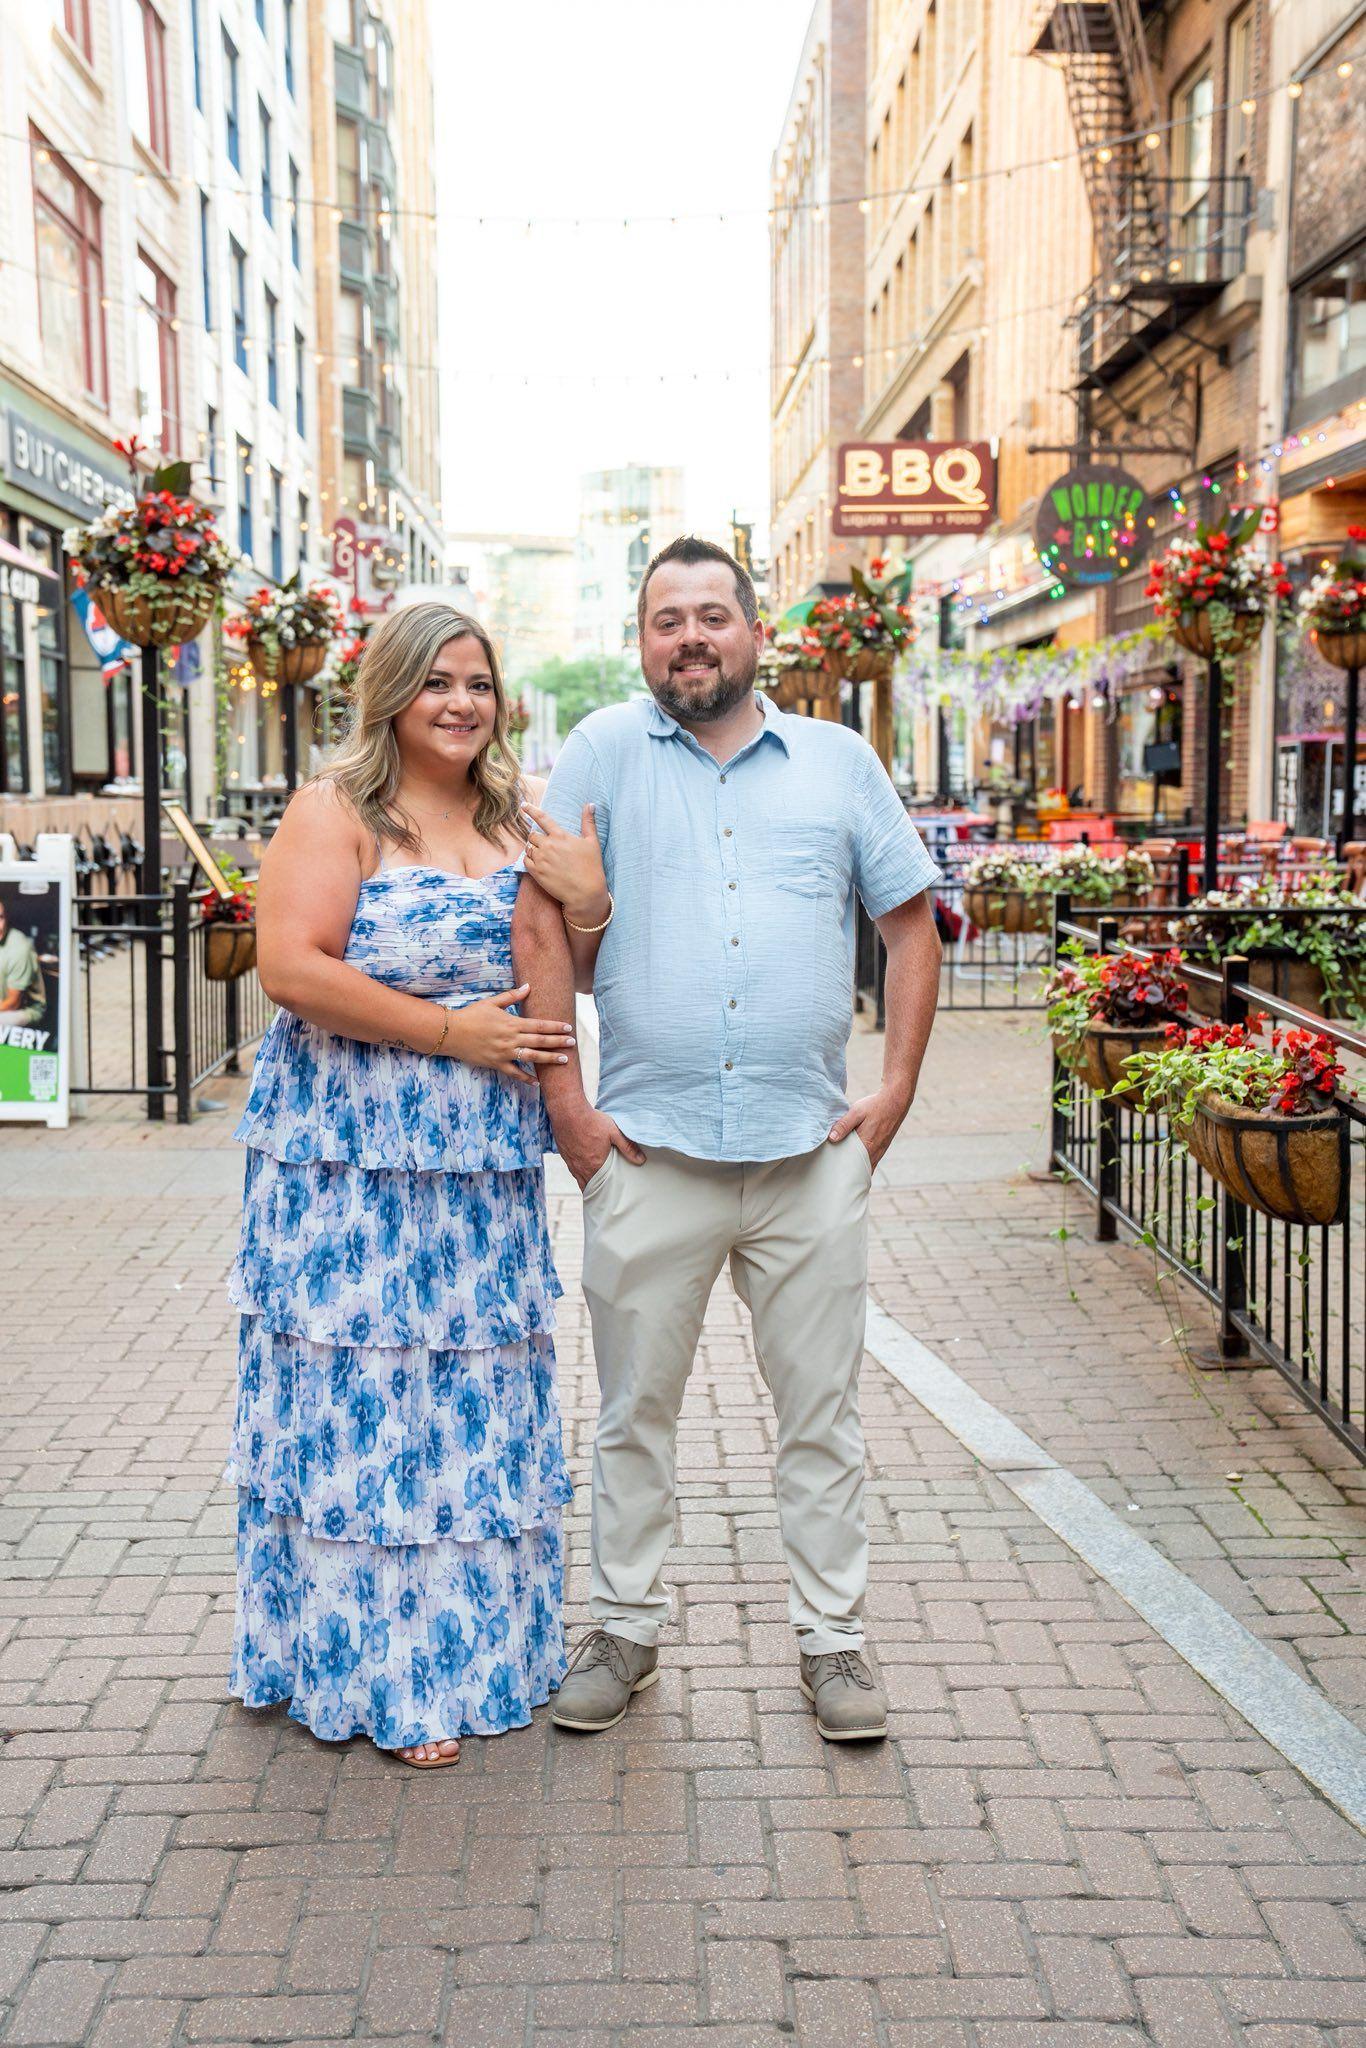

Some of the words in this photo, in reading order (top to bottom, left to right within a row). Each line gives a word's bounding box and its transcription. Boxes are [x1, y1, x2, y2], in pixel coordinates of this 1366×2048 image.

[14, 426, 104, 507] BUTCHER
[845, 448, 986, 504] BBQ
[1051, 483, 1143, 521] WONDER
